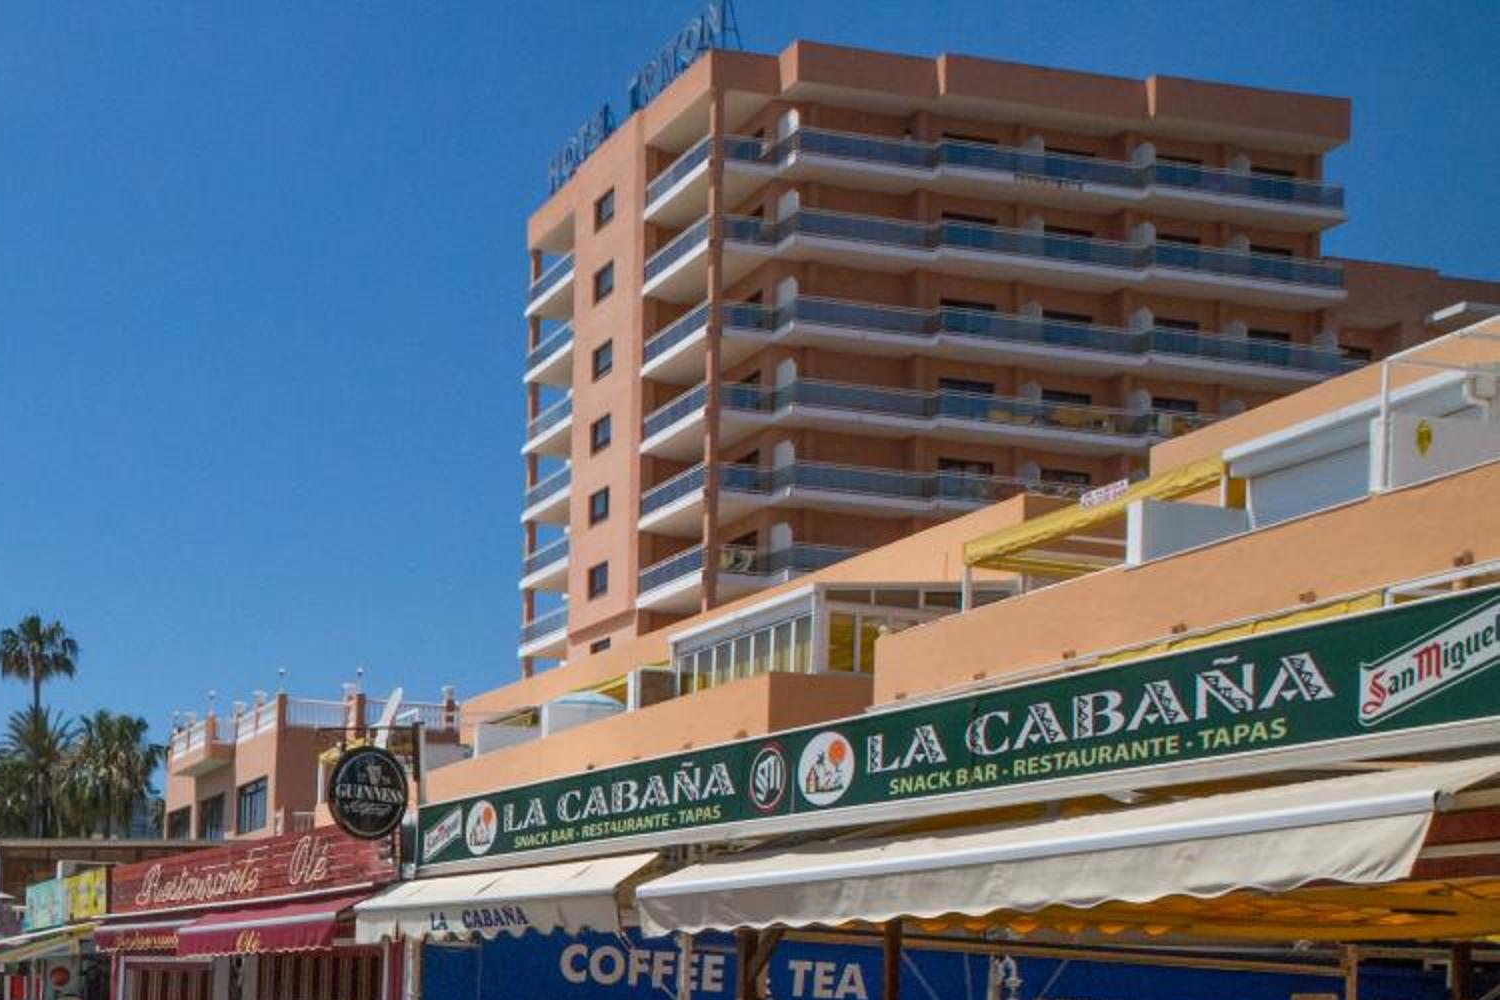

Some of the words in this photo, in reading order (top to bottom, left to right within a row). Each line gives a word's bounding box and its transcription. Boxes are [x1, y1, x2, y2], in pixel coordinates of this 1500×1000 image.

[867, 723, 947, 774] LA
[965, 654, 1334, 757] CABAÑA
[888, 769, 951, 796] SNACK
[955, 762, 998, 785] BAR
[1012, 734, 1180, 778] RESTAURANTE
[1198, 716, 1288, 751] TAPAS
[503, 797, 547, 833] LA
[556, 761, 736, 823] CABAÑA
[513, 830, 551, 849] SNACK
[551, 828, 575, 844] BAR
[581, 811, 670, 838] RESTAURANTE
[678, 803, 722, 825] TAPAS
[429, 910, 449, 931] LA
[788, 959, 868, 1000] TEA
